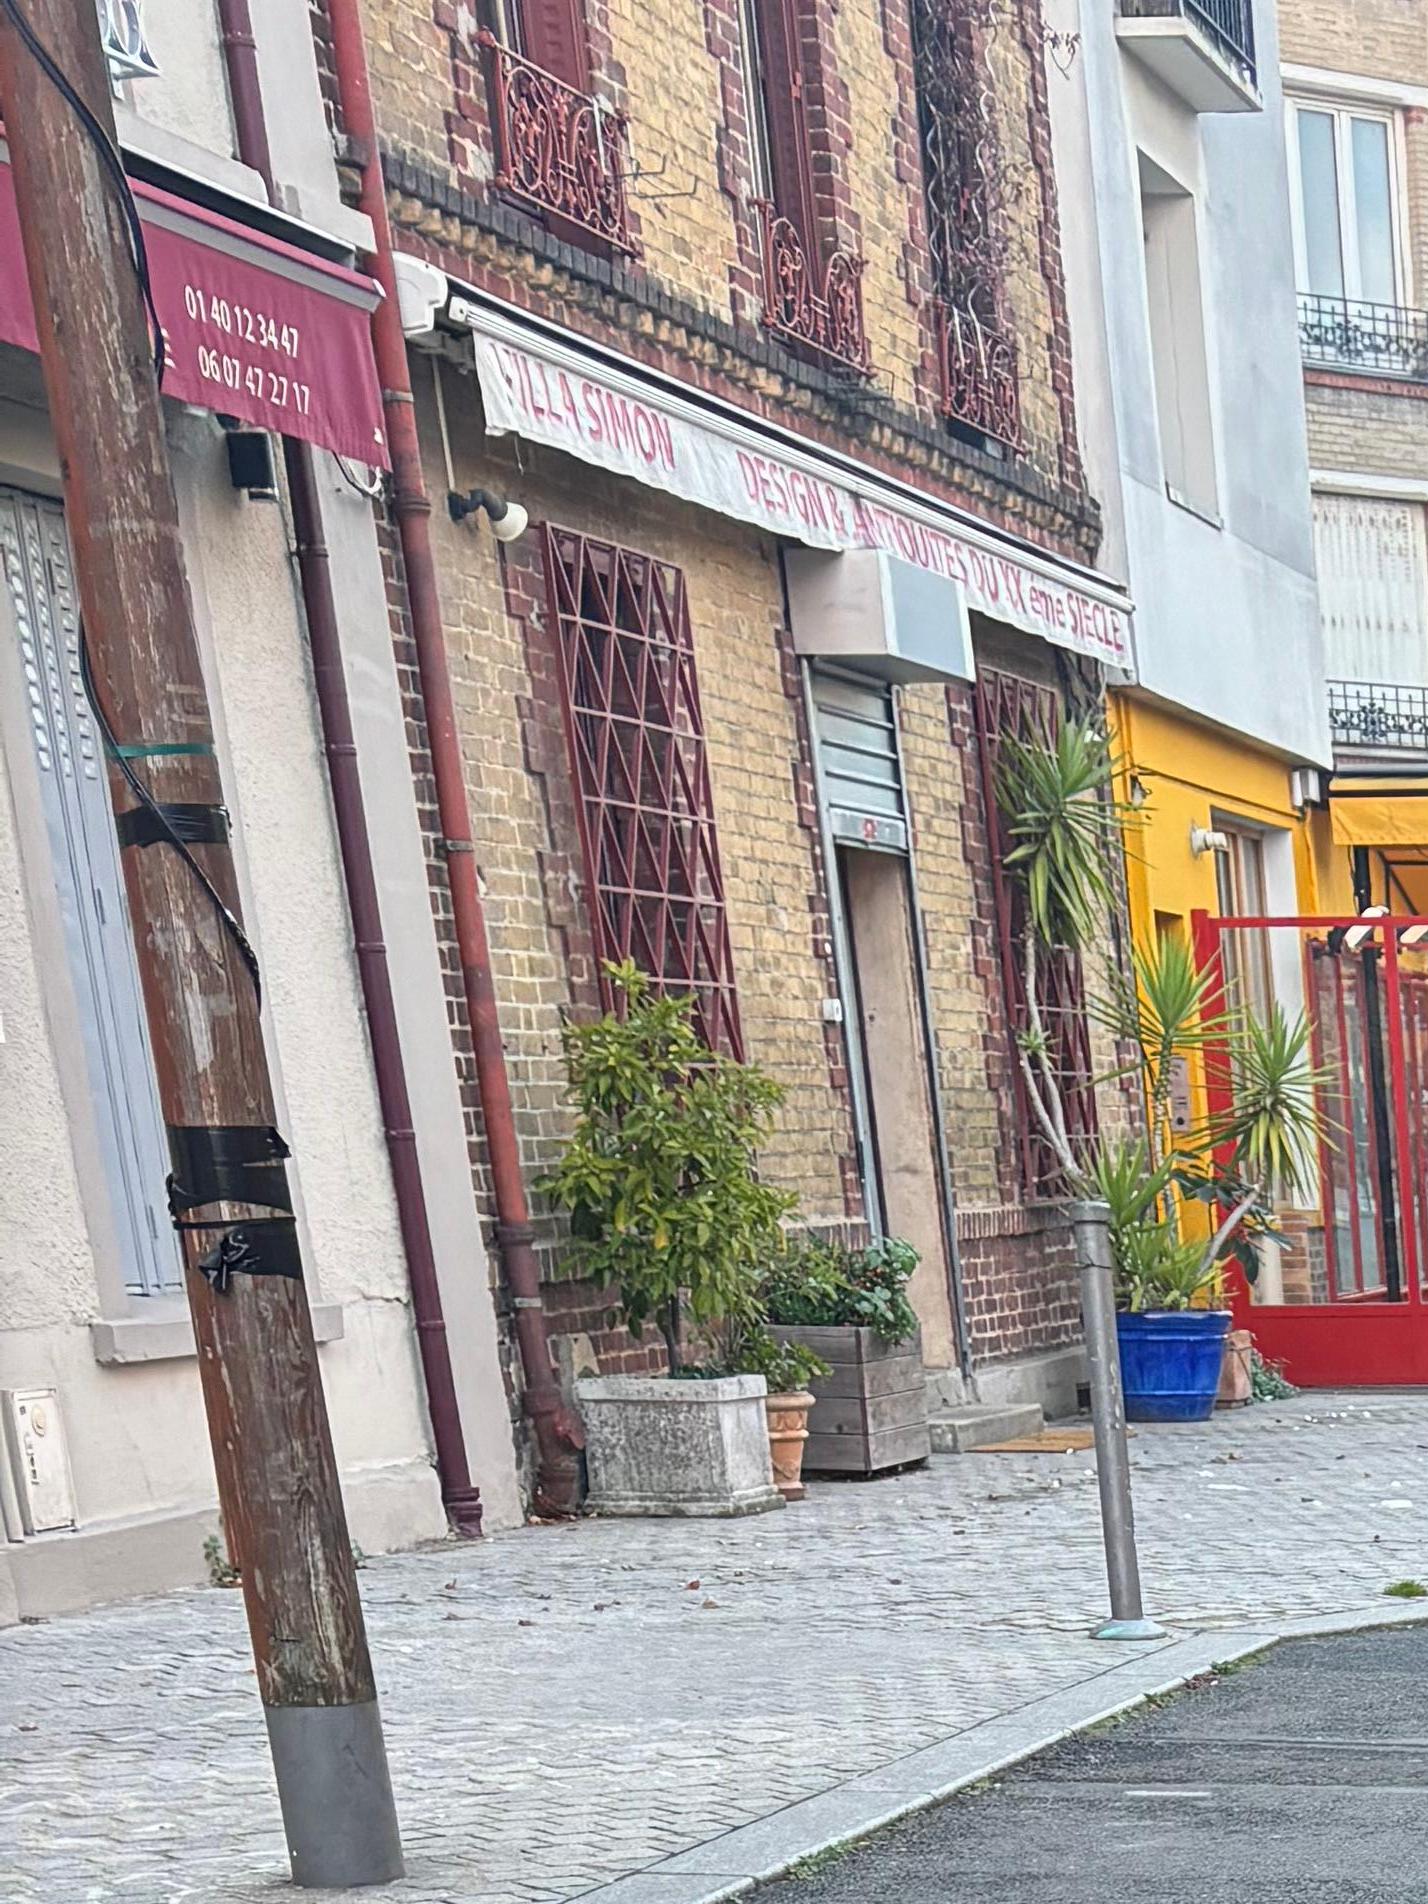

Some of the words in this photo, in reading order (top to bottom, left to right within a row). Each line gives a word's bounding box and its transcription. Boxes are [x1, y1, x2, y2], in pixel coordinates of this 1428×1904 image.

[185, 285, 207, 323] 01
[211, 295, 231, 334] 40
[234, 305, 257, 343] 12
[257, 313, 279, 350] 34
[281, 323, 299, 358] 47
[198, 345, 221, 383] 06
[222, 354, 240, 390] 07
[245, 365, 263, 398] 47
[267, 372, 288, 406] 27
[292, 382, 310, 415] 17
[581, 379, 676, 471] SIMON
[736, 450, 830, 530] DESIGN
[825, 483, 848, 537] &
[968, 549, 999, 603] DU
[998, 560, 1028, 616] XX
